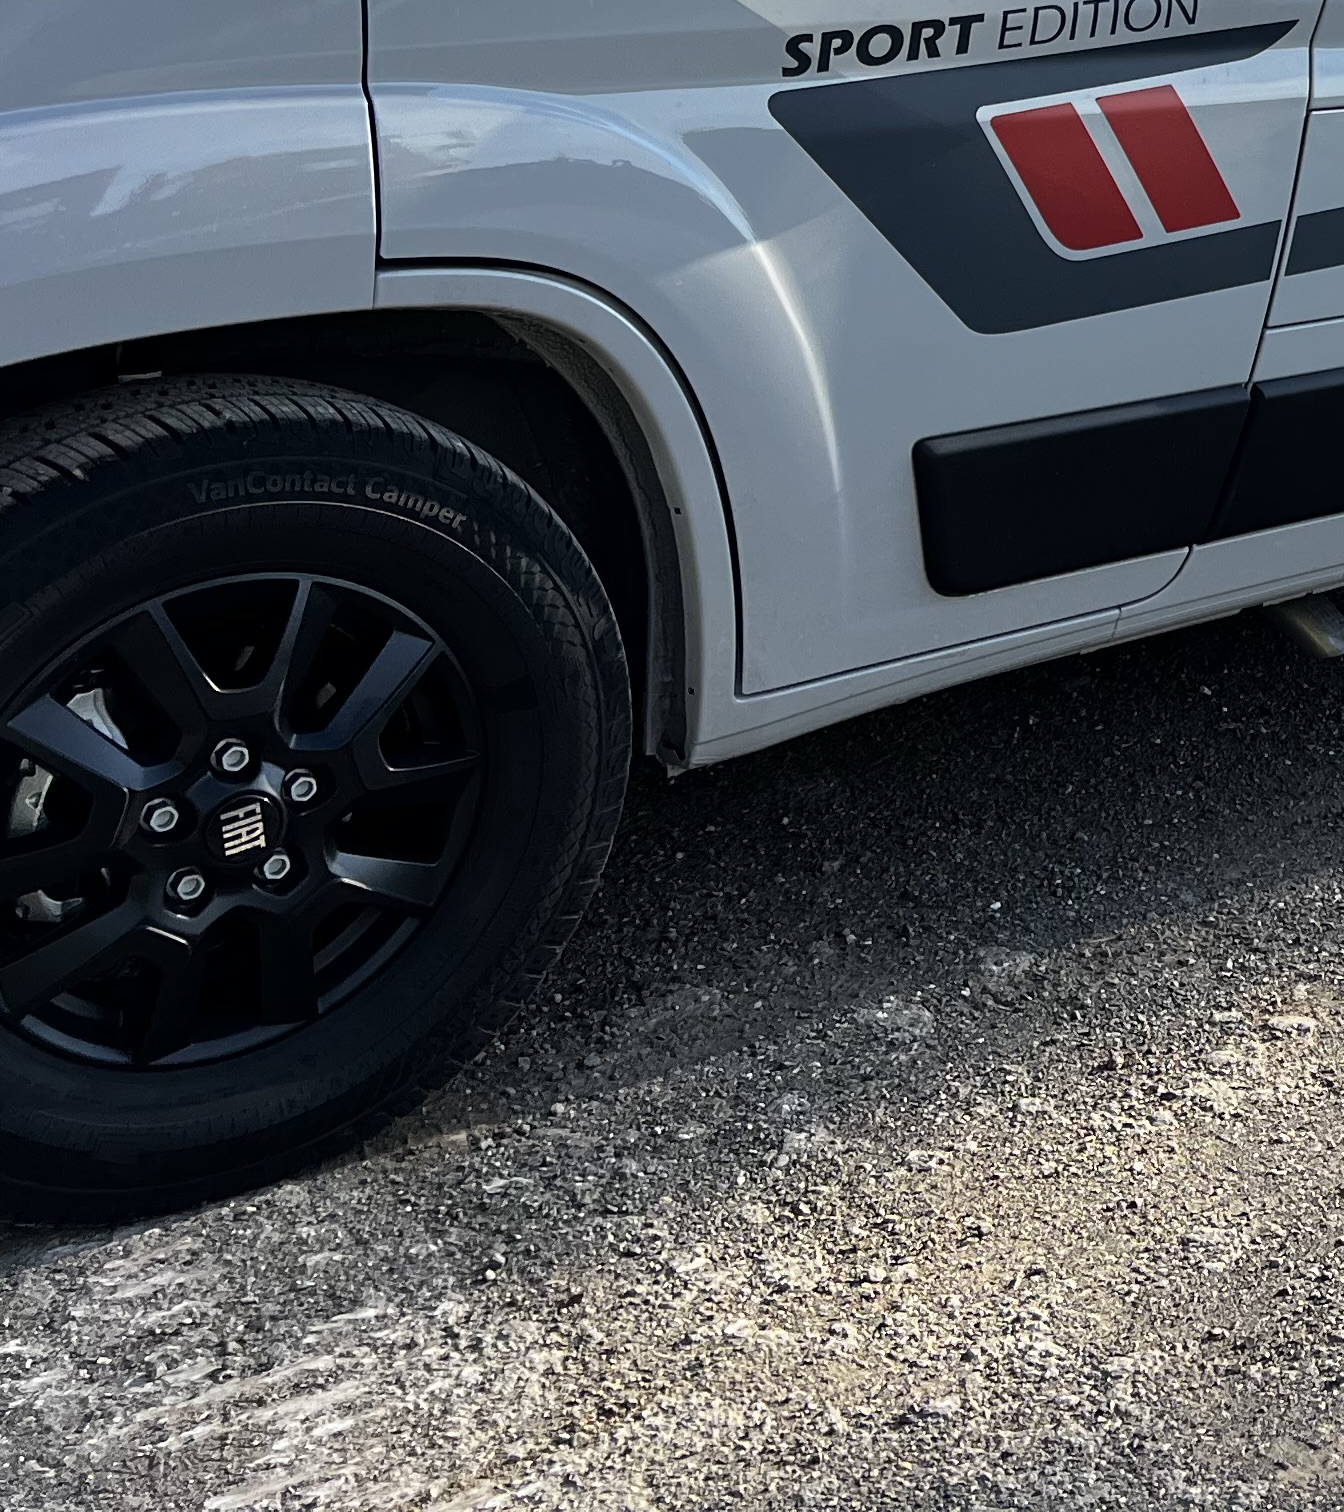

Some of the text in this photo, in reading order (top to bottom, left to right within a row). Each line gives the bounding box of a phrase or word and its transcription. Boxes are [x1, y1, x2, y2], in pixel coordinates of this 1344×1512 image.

[781, 14, 985, 77] SPORT
[187, 470, 467, 529] VanContact Camper
[220, 801, 266, 856] FIAT
